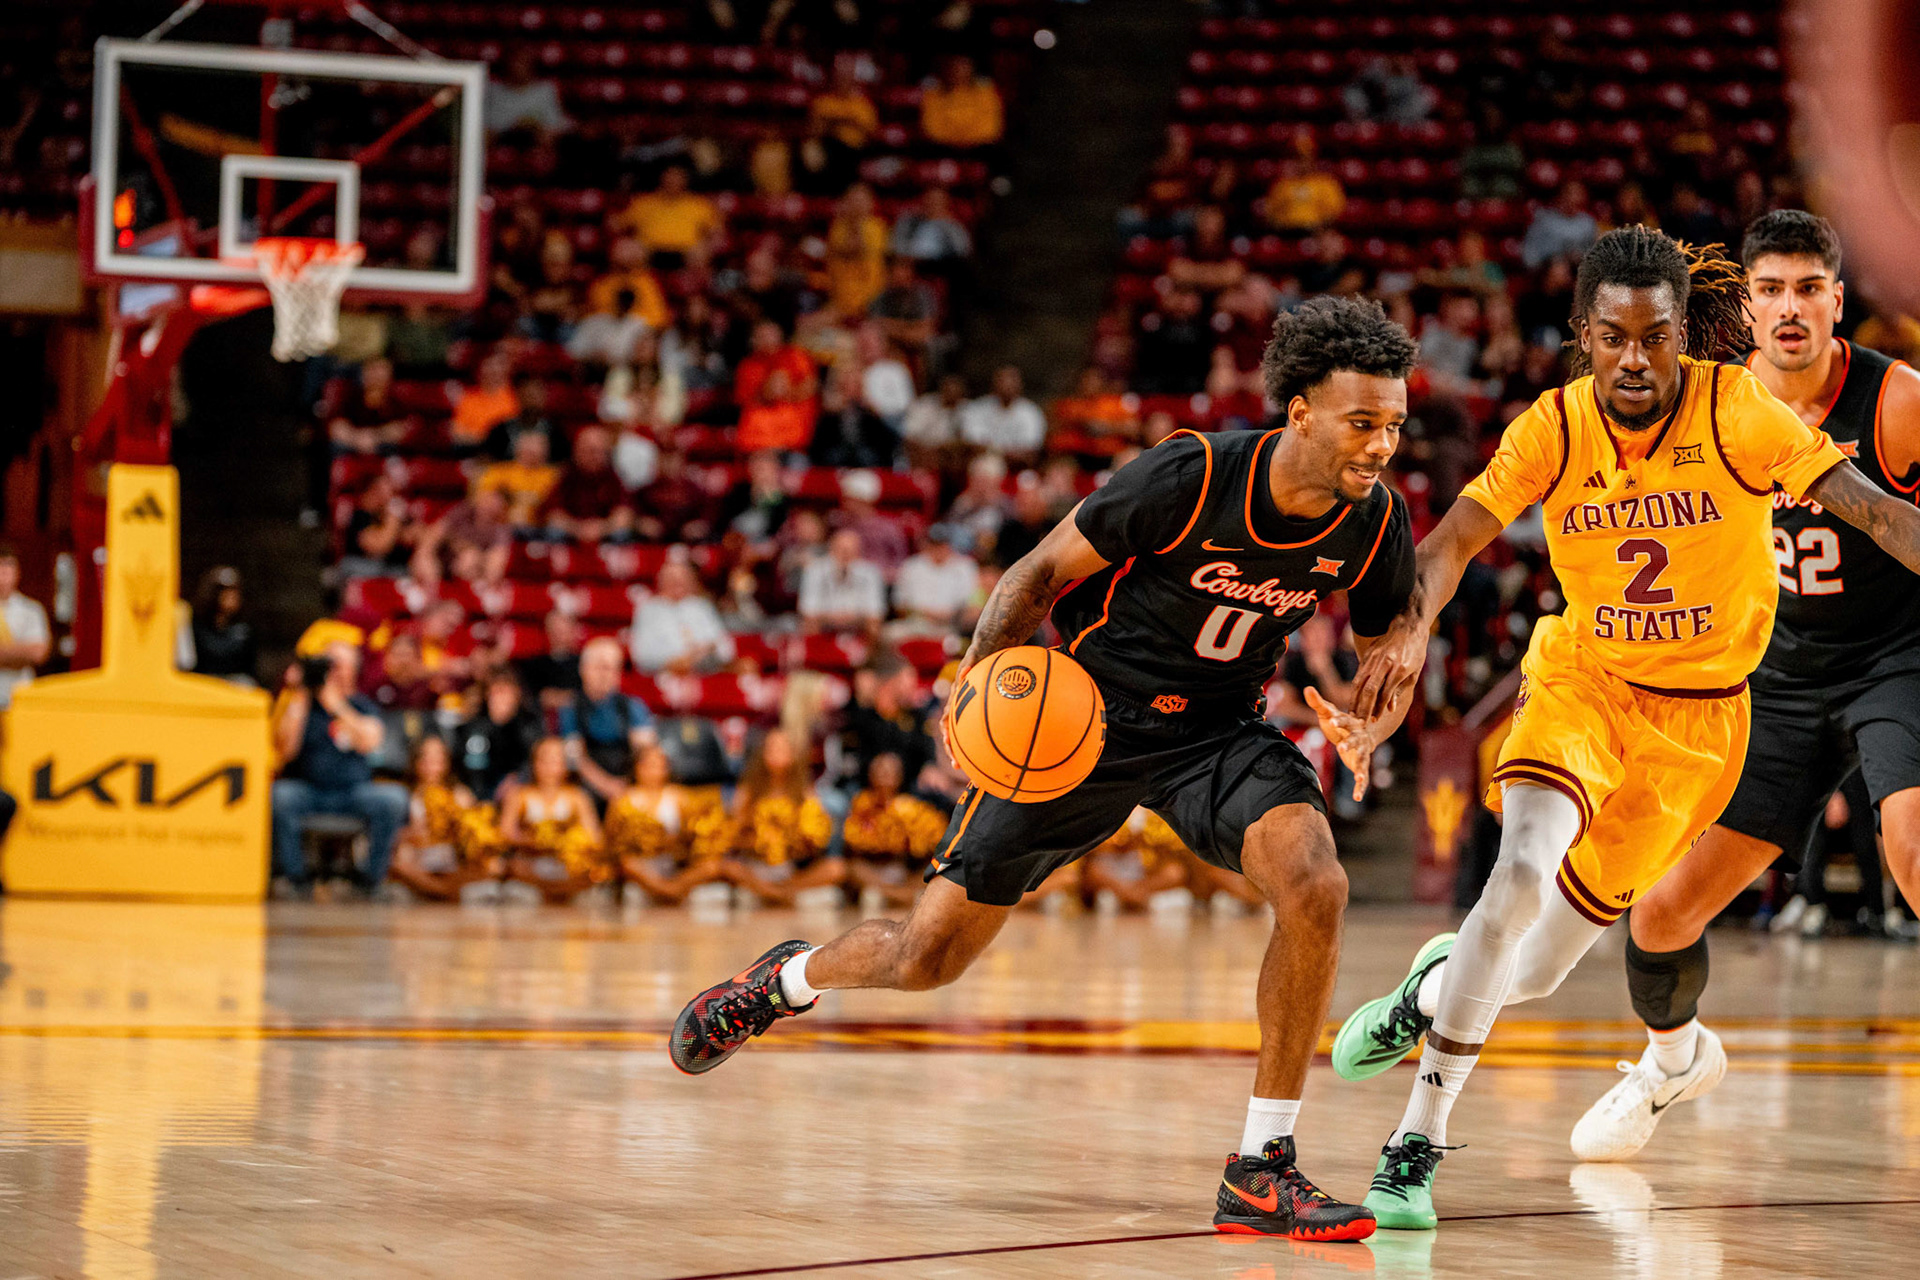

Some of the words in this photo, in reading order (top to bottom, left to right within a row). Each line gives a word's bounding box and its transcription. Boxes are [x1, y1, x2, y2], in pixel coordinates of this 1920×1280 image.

[1561, 490, 1723, 535] ARIZONA
[1616, 538, 1675, 604] 2
[1772, 527, 1844, 596] 22
[1190, 561, 1318, 617] Cowboys
[1193, 605, 1263, 663] 0
[1594, 604, 1713, 642] STATE
[1150, 695, 1189, 714] OSU
[32, 755, 247, 808] KIA
